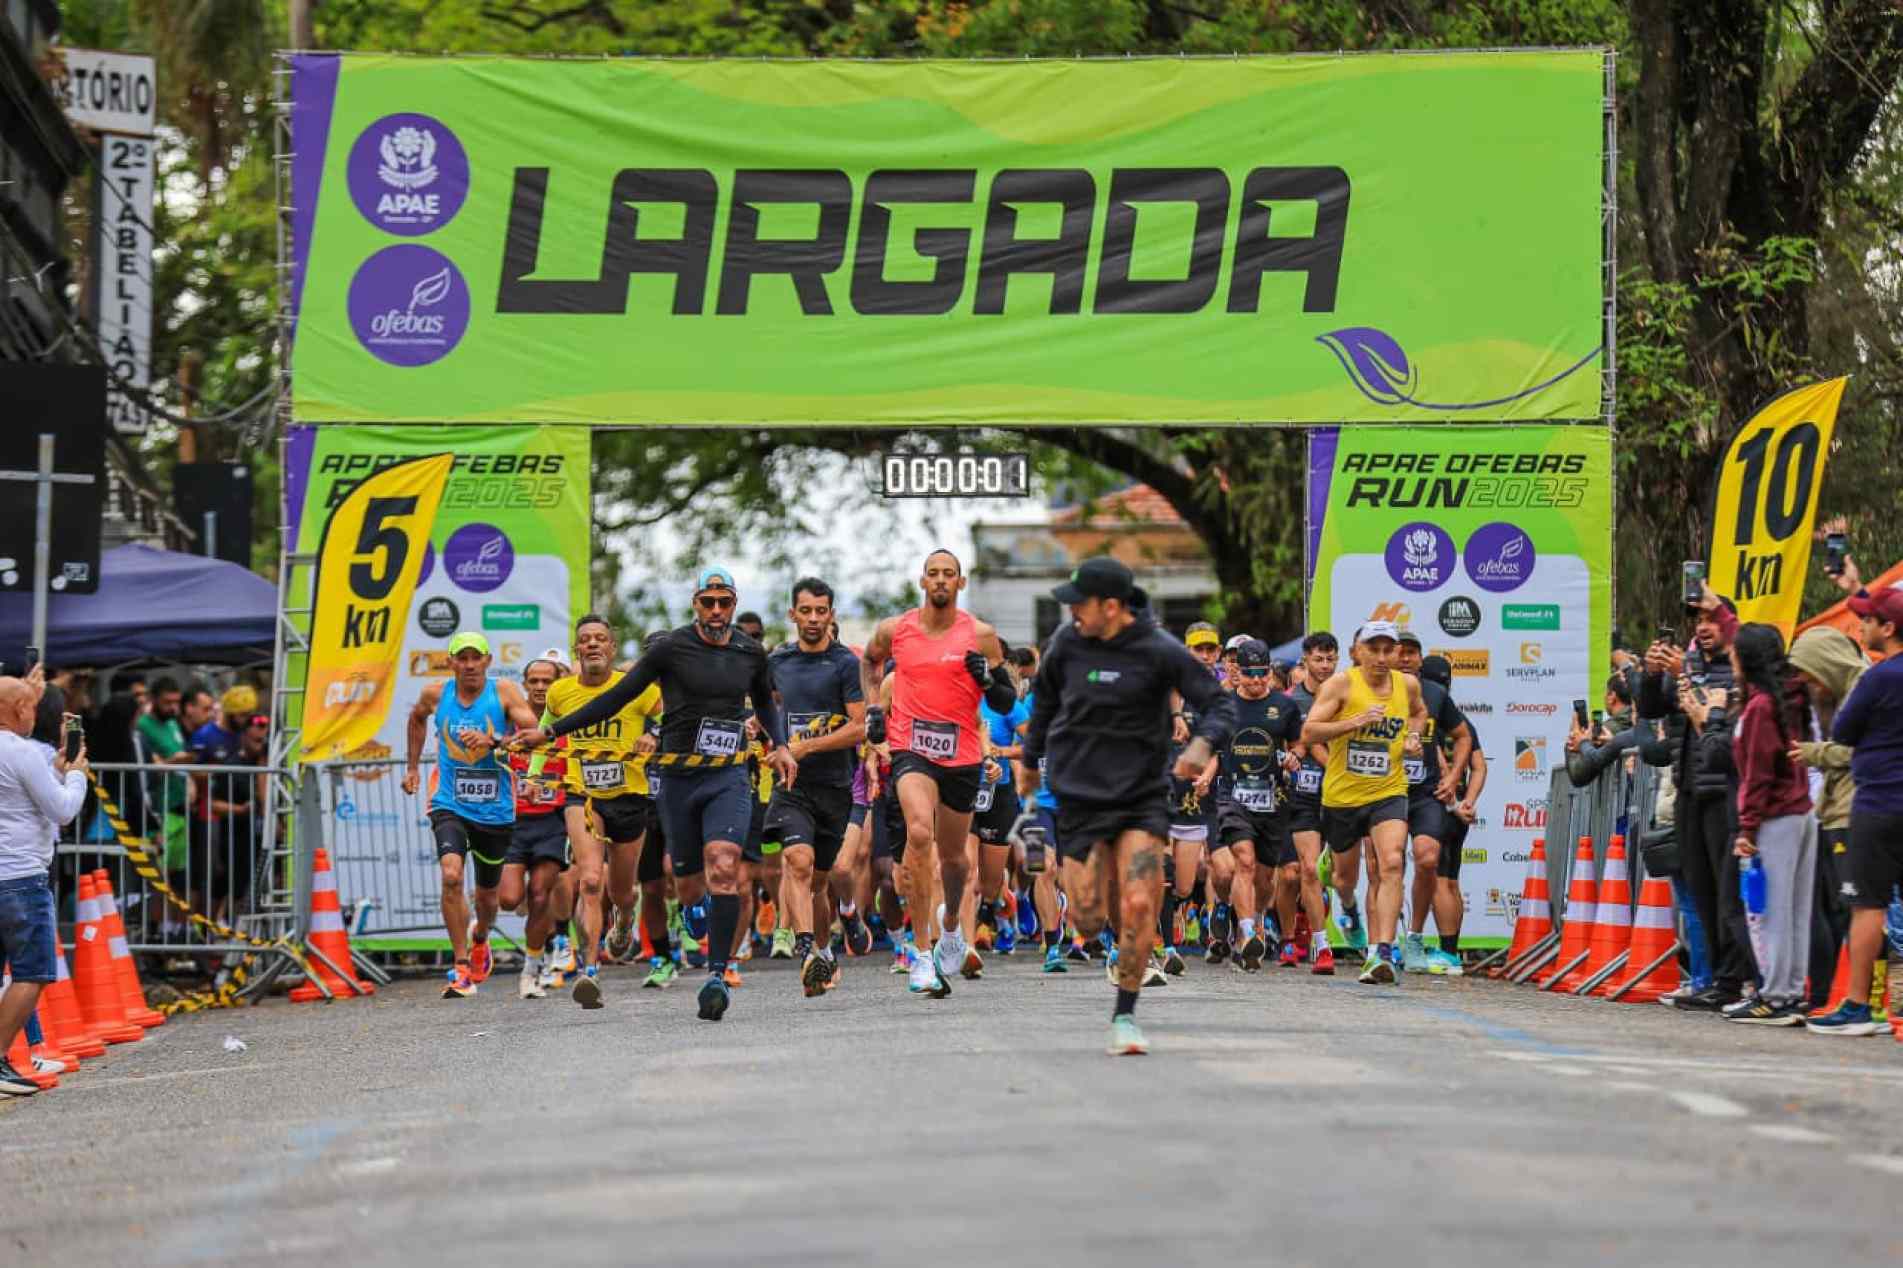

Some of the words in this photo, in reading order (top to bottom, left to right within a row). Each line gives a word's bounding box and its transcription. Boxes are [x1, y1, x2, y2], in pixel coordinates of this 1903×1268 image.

[65, 60, 153, 114] TÓRIO
[377, 193, 440, 215] APAE
[496, 165, 1350, 316] LARGADA
[371, 308, 444, 337] ofebas
[320, 454, 410, 473] APA
[451, 454, 564, 473] FEBAS
[1342, 453, 1439, 473] APAE
[1445, 453, 1587, 474] OFEBAS
[1734, 422, 1820, 542] 10
[349, 495, 419, 600] 5
[1402, 567, 1438, 580] APAE
[1476, 559, 1520, 577] ofebas
[917, 735, 950, 751] 1020
[1351, 756, 1384, 768] 1262
[459, 782, 493, 796] 1058
